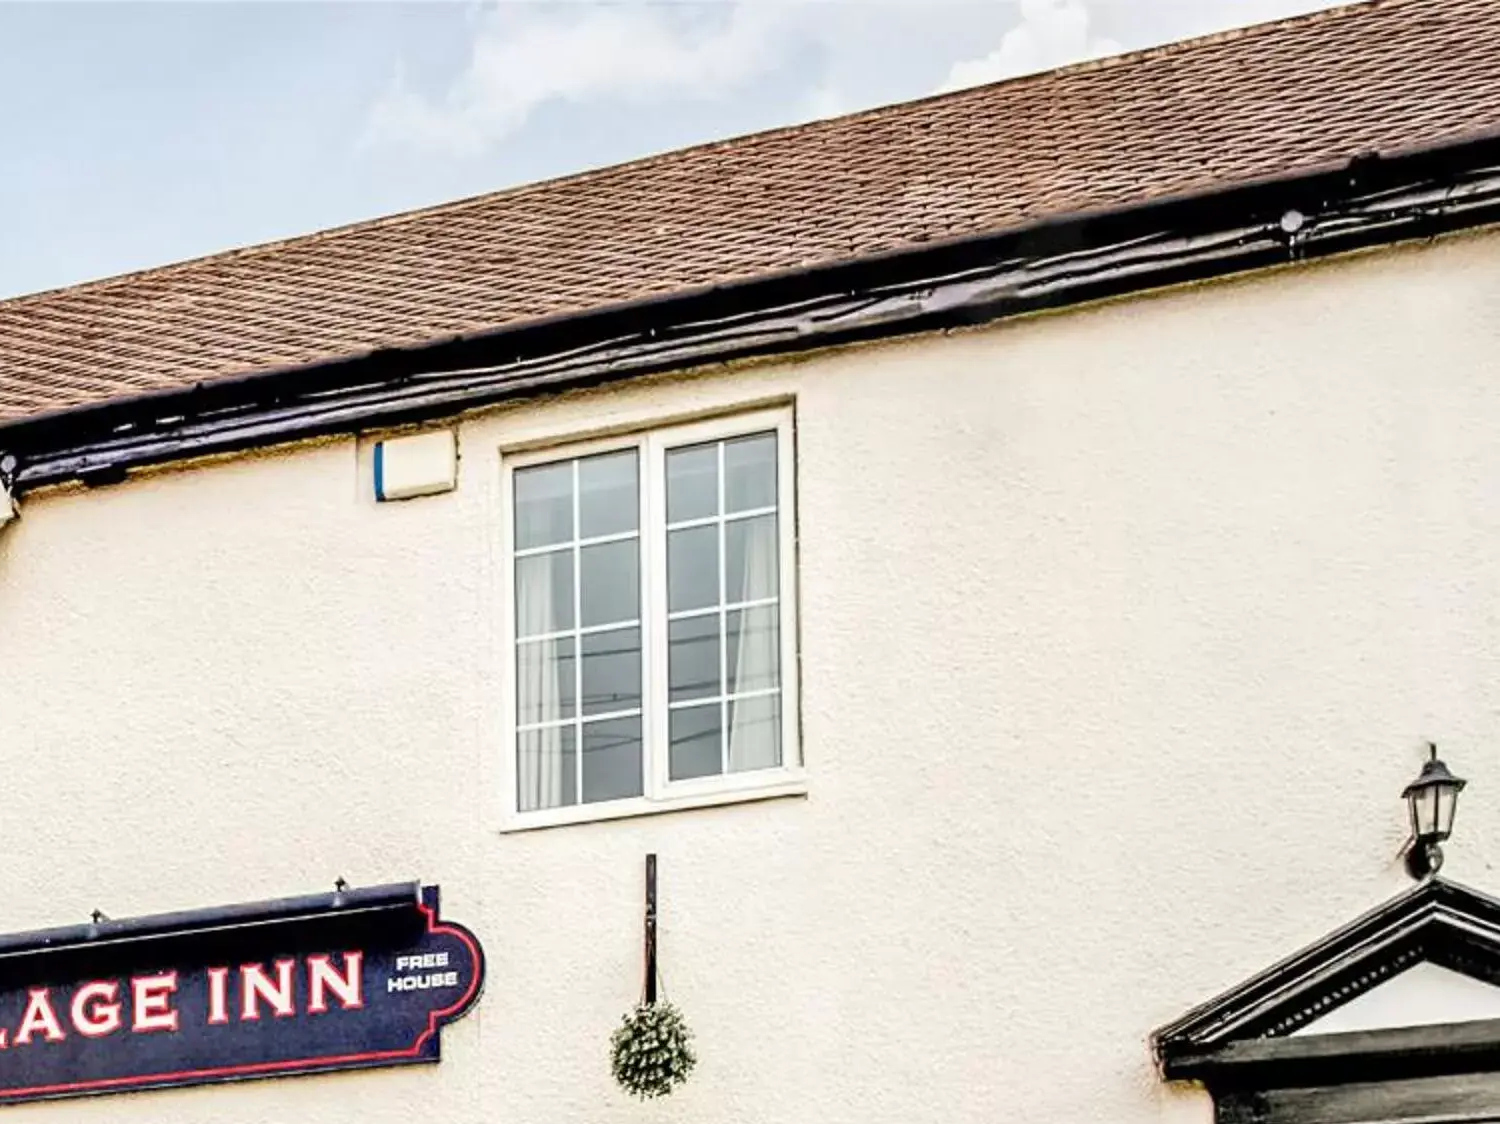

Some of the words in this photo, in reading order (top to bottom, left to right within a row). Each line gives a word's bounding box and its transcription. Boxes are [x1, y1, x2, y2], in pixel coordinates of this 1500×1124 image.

[396, 952, 449, 971] FREE
[206, 950, 365, 1026] INN
[387, 971, 459, 993] HOUSE
